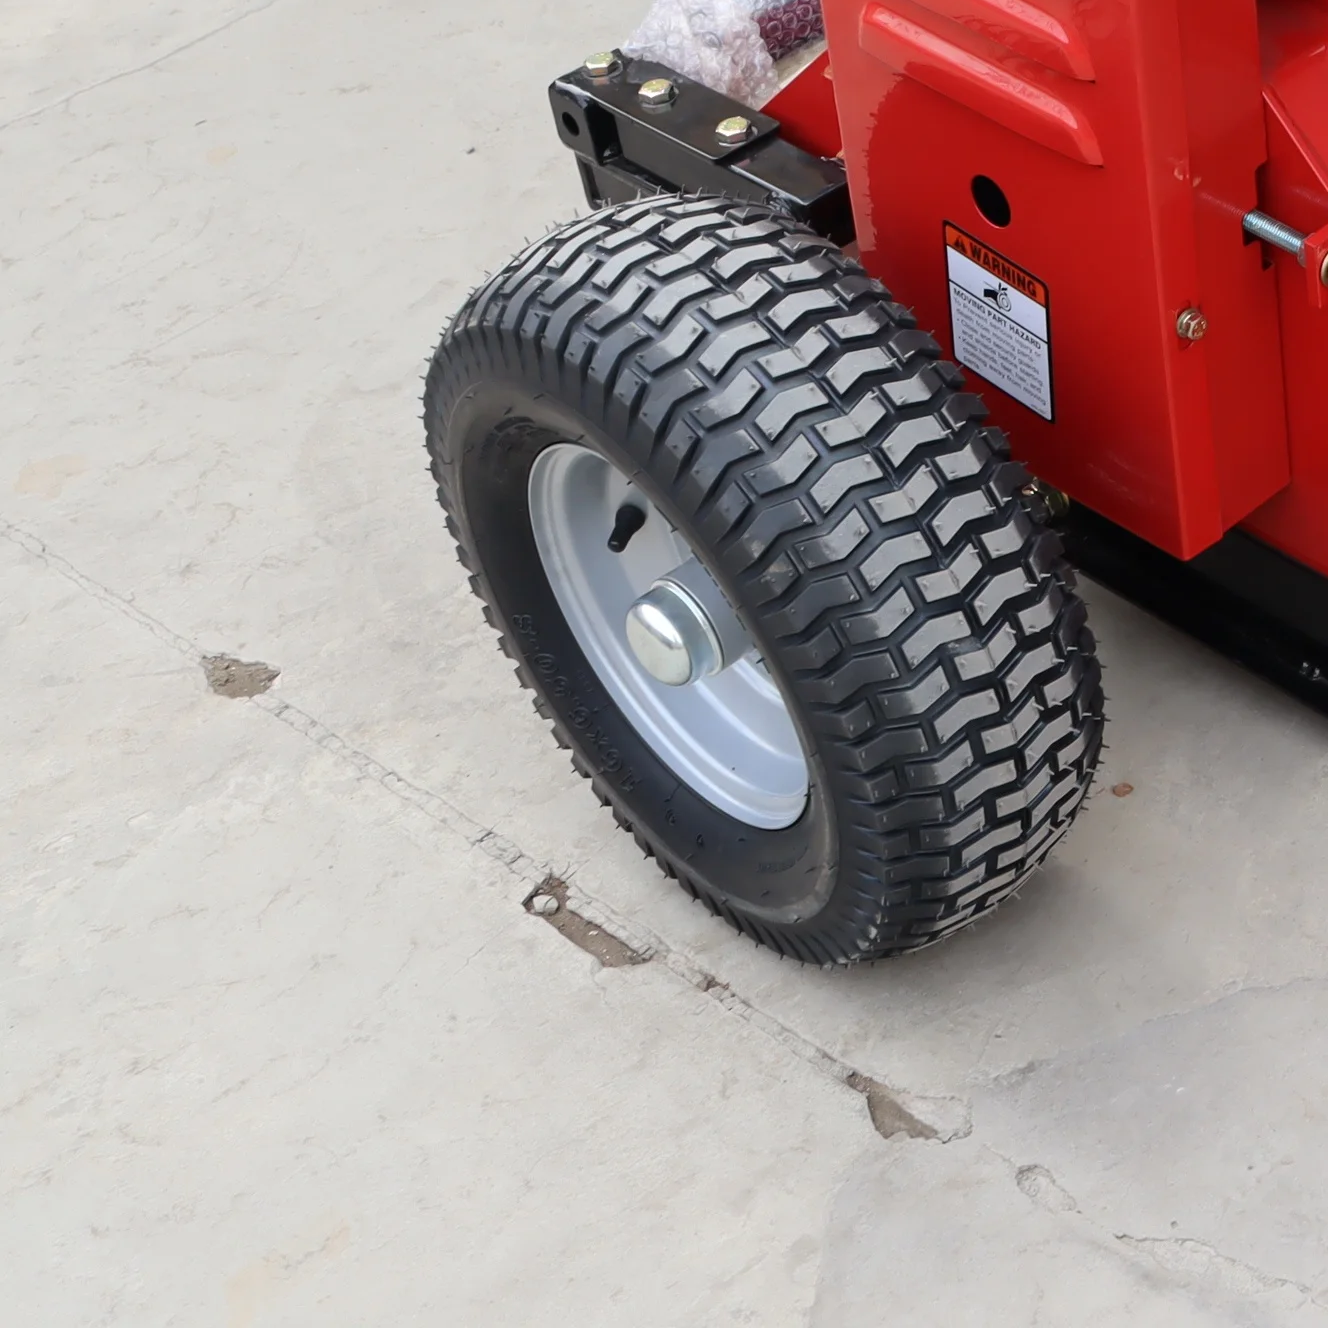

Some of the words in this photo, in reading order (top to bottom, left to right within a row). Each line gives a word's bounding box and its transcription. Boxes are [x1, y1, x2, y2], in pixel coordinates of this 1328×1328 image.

[970, 242, 1037, 298] WARNING
[954, 287, 986, 314] MOVING
[987, 309, 1008, 329] PART
[1009, 323, 1041, 351] HAZARD
